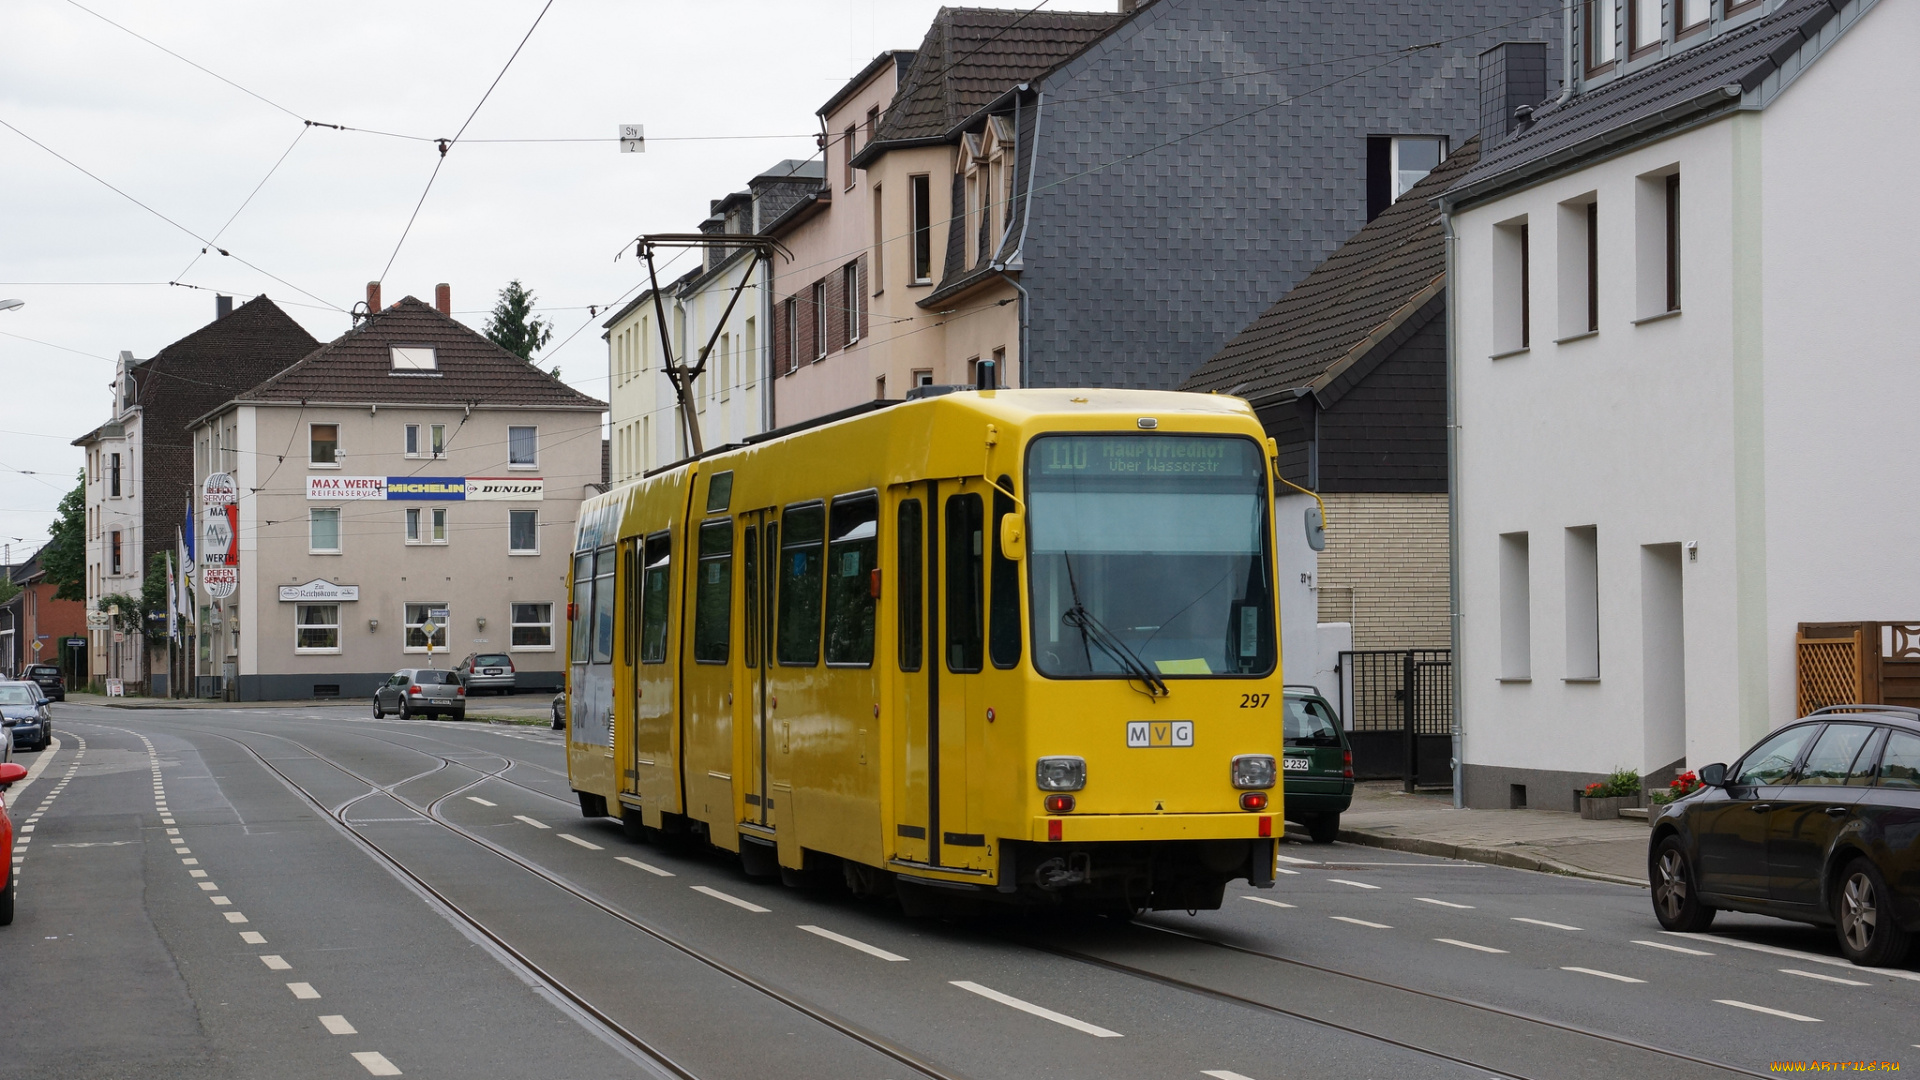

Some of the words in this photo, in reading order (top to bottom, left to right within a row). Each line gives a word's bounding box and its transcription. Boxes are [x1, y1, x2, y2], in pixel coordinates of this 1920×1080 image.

[625, 126, 638, 137] Sty
[630, 141, 636, 152] 2
[1102, 441, 1225, 458] Hauptfriedhof
[1048, 442, 1087, 469] 110
[1147, 459, 1220, 472] Wasserstr
[311, 479, 340, 488] MAX
[343, 479, 382, 488] WERTH
[387, 483, 465, 493] MICHELIN
[481, 485, 542, 493] DUNLOP
[203, 494, 236, 502] SERVICE
[210, 507, 230, 517] MAX
[205, 553, 235, 563] WERTH
[207, 569, 234, 577] REIFEN
[204, 576, 236, 584] SERVICE
[1239, 693, 1271, 709] 297
[1291, 760, 1308, 770] 232
[986, 844, 993, 857] 2
